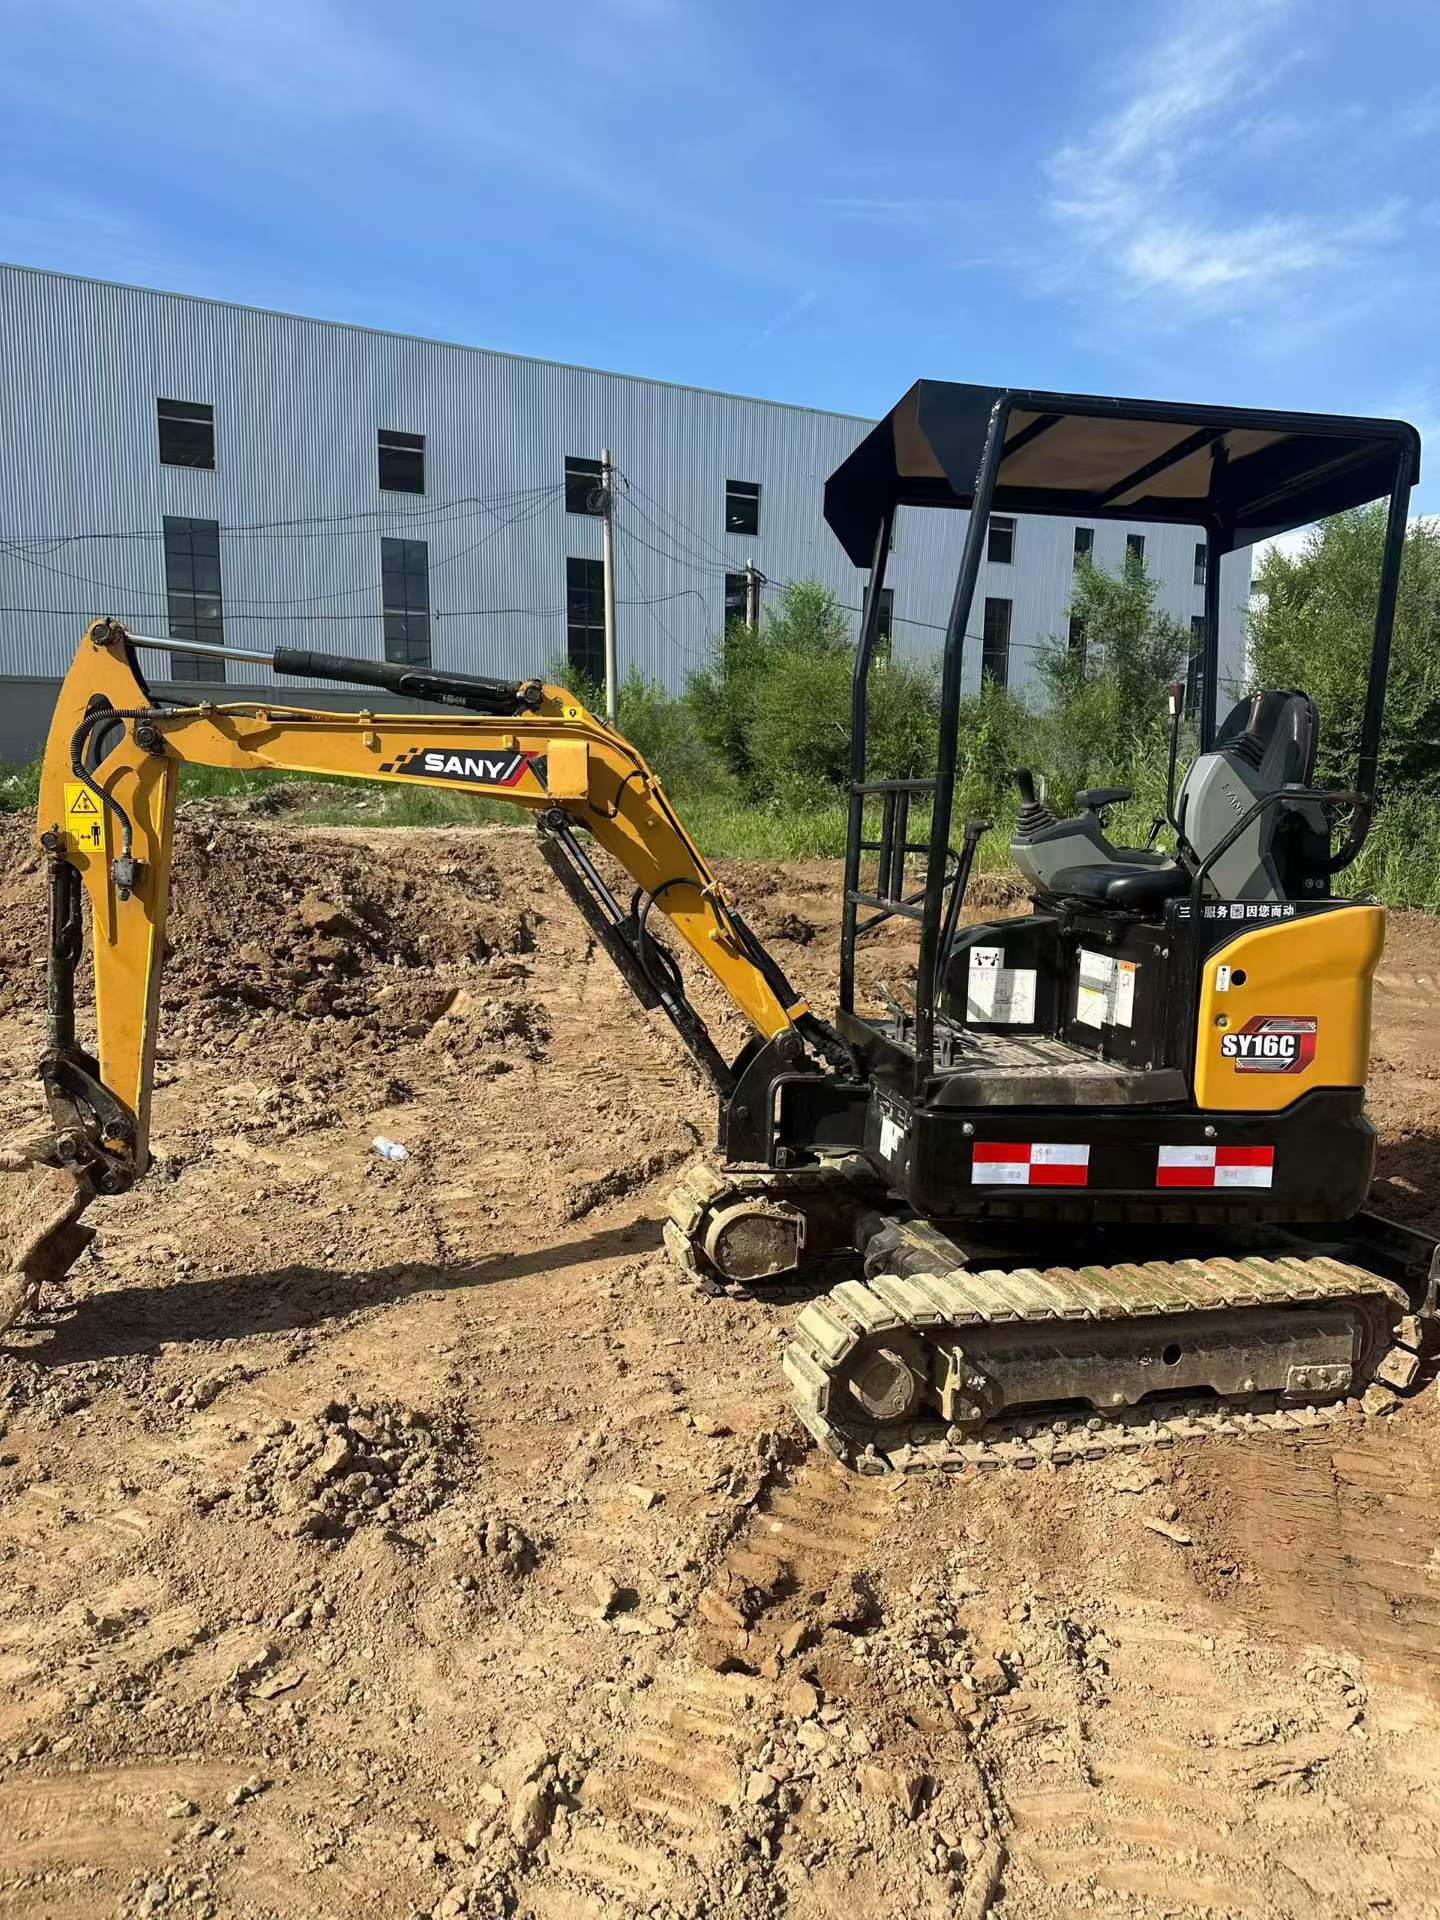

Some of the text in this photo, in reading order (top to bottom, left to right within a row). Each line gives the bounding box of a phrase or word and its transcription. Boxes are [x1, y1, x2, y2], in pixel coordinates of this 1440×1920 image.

[424, 753, 505, 779] SANY
[1178, 904, 1295, 918] 三服务 因您而动
[1222, 1034, 1295, 1058] SY16C
